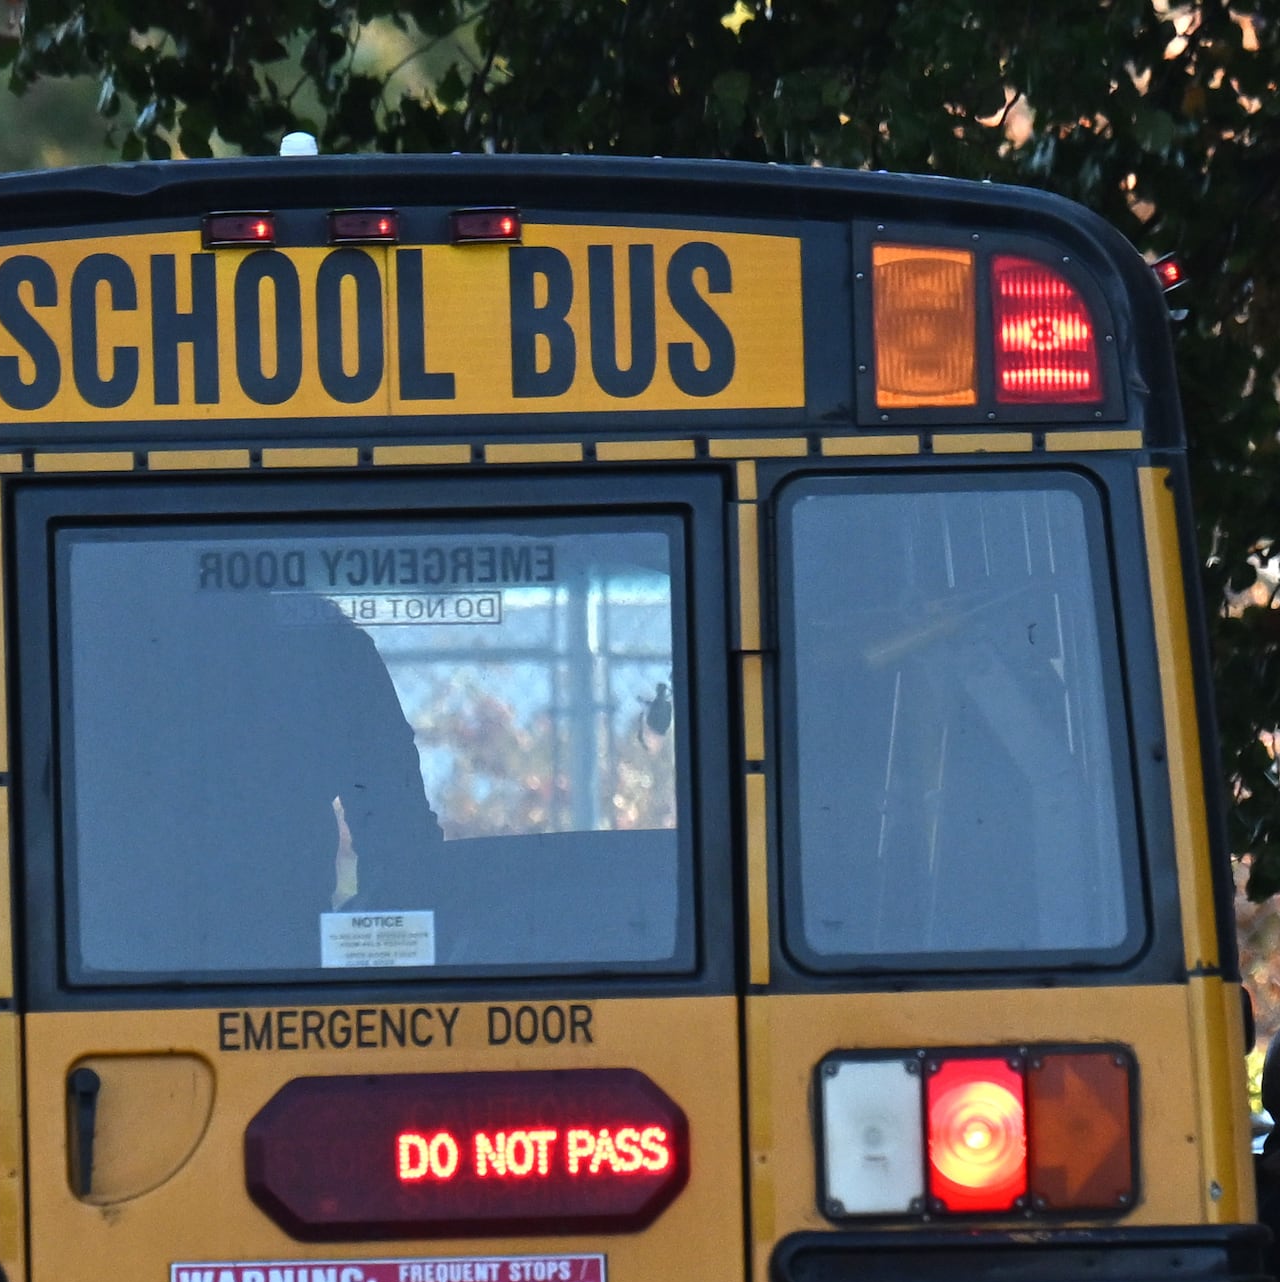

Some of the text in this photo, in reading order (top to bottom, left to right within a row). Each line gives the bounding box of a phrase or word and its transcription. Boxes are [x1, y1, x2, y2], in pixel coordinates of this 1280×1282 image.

[509, 240, 736, 402] BUS
[351, 916, 404, 929] NOTICE
[219, 1005, 594, 1051] EMERGENCY DOOR
[398, 1132, 459, 1180] DO
[476, 1129, 558, 1177] NOT
[567, 1126, 670, 1174] PASS
[509, 1260, 571, 1282] STOPS
